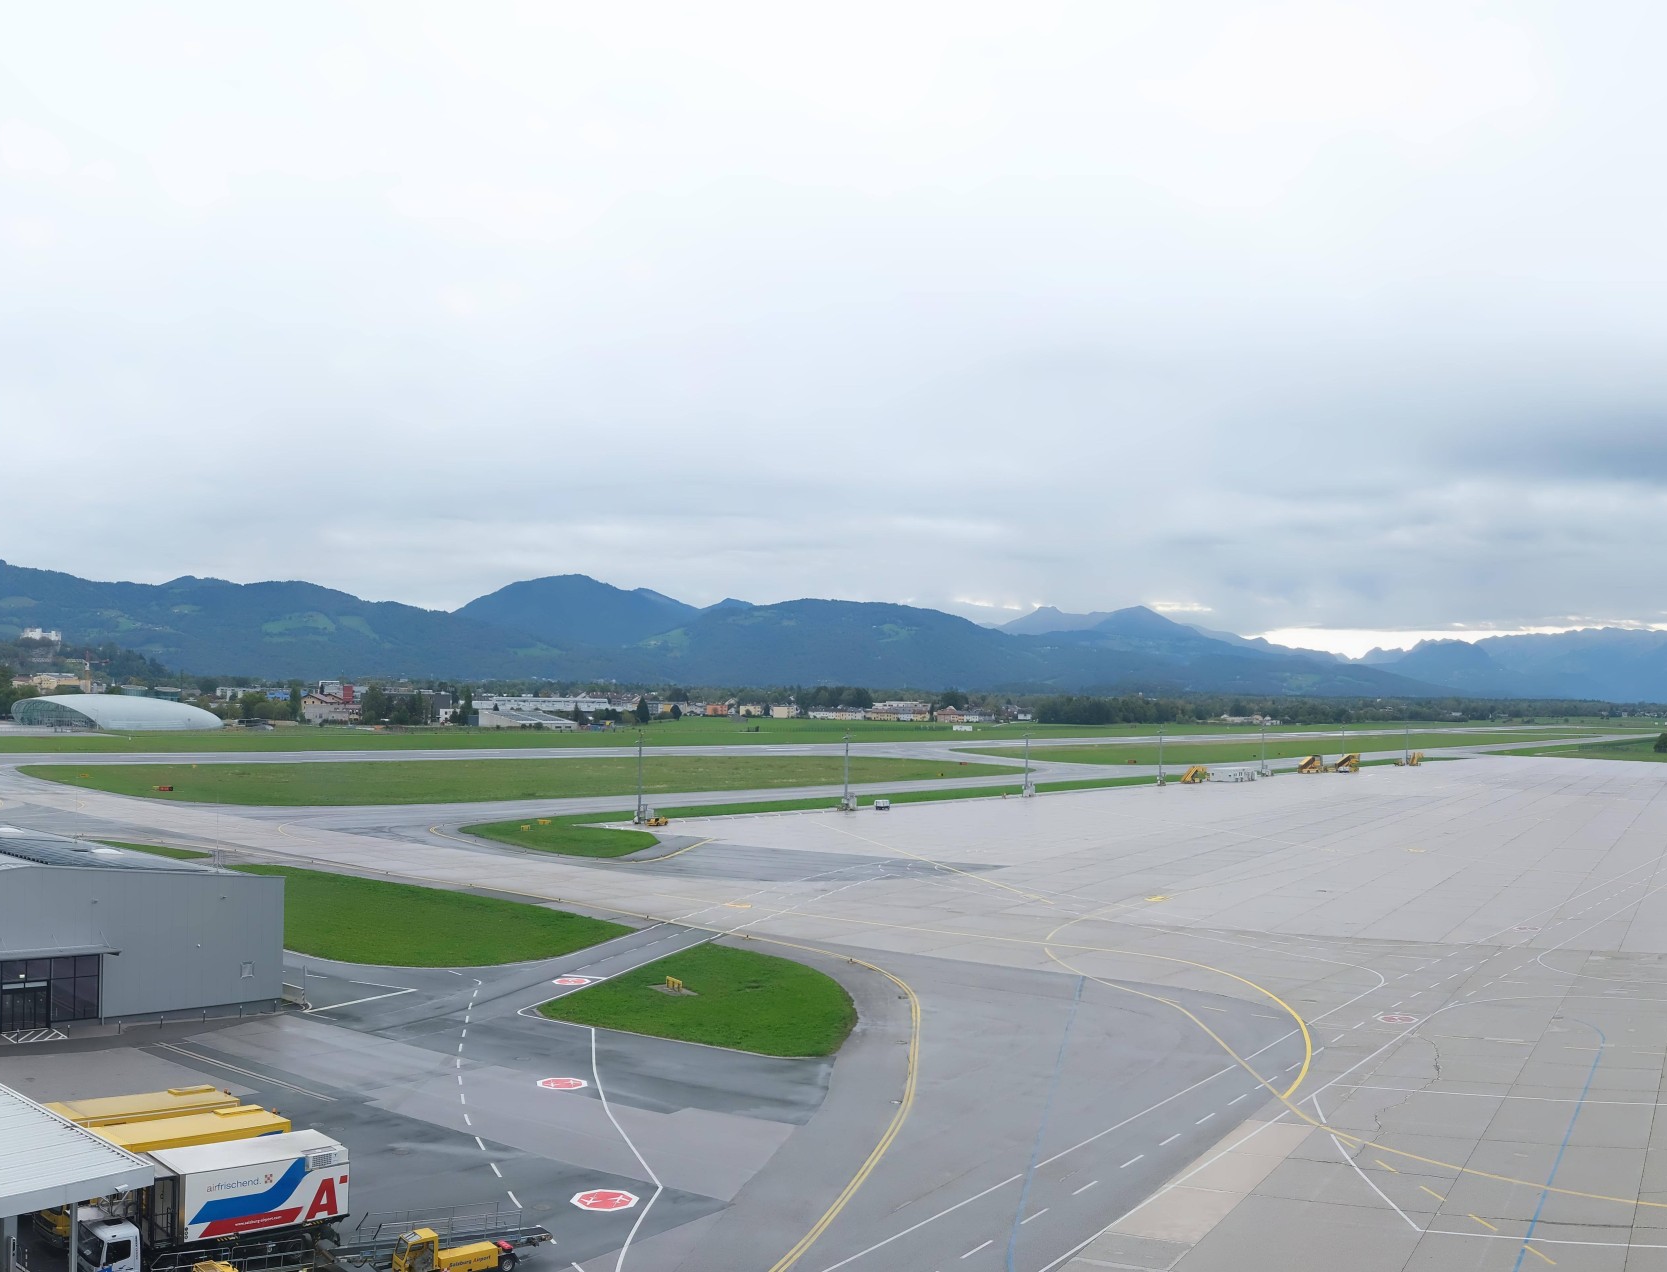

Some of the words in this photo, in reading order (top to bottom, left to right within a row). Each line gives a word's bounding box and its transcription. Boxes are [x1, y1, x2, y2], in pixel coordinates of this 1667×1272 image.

[206, 1177, 262, 1193] airfrischend.
[305, 1177, 338, 1221] A
[449, 1259, 473, 1268] Salzburg
[473, 1255, 491, 1264] Airport
